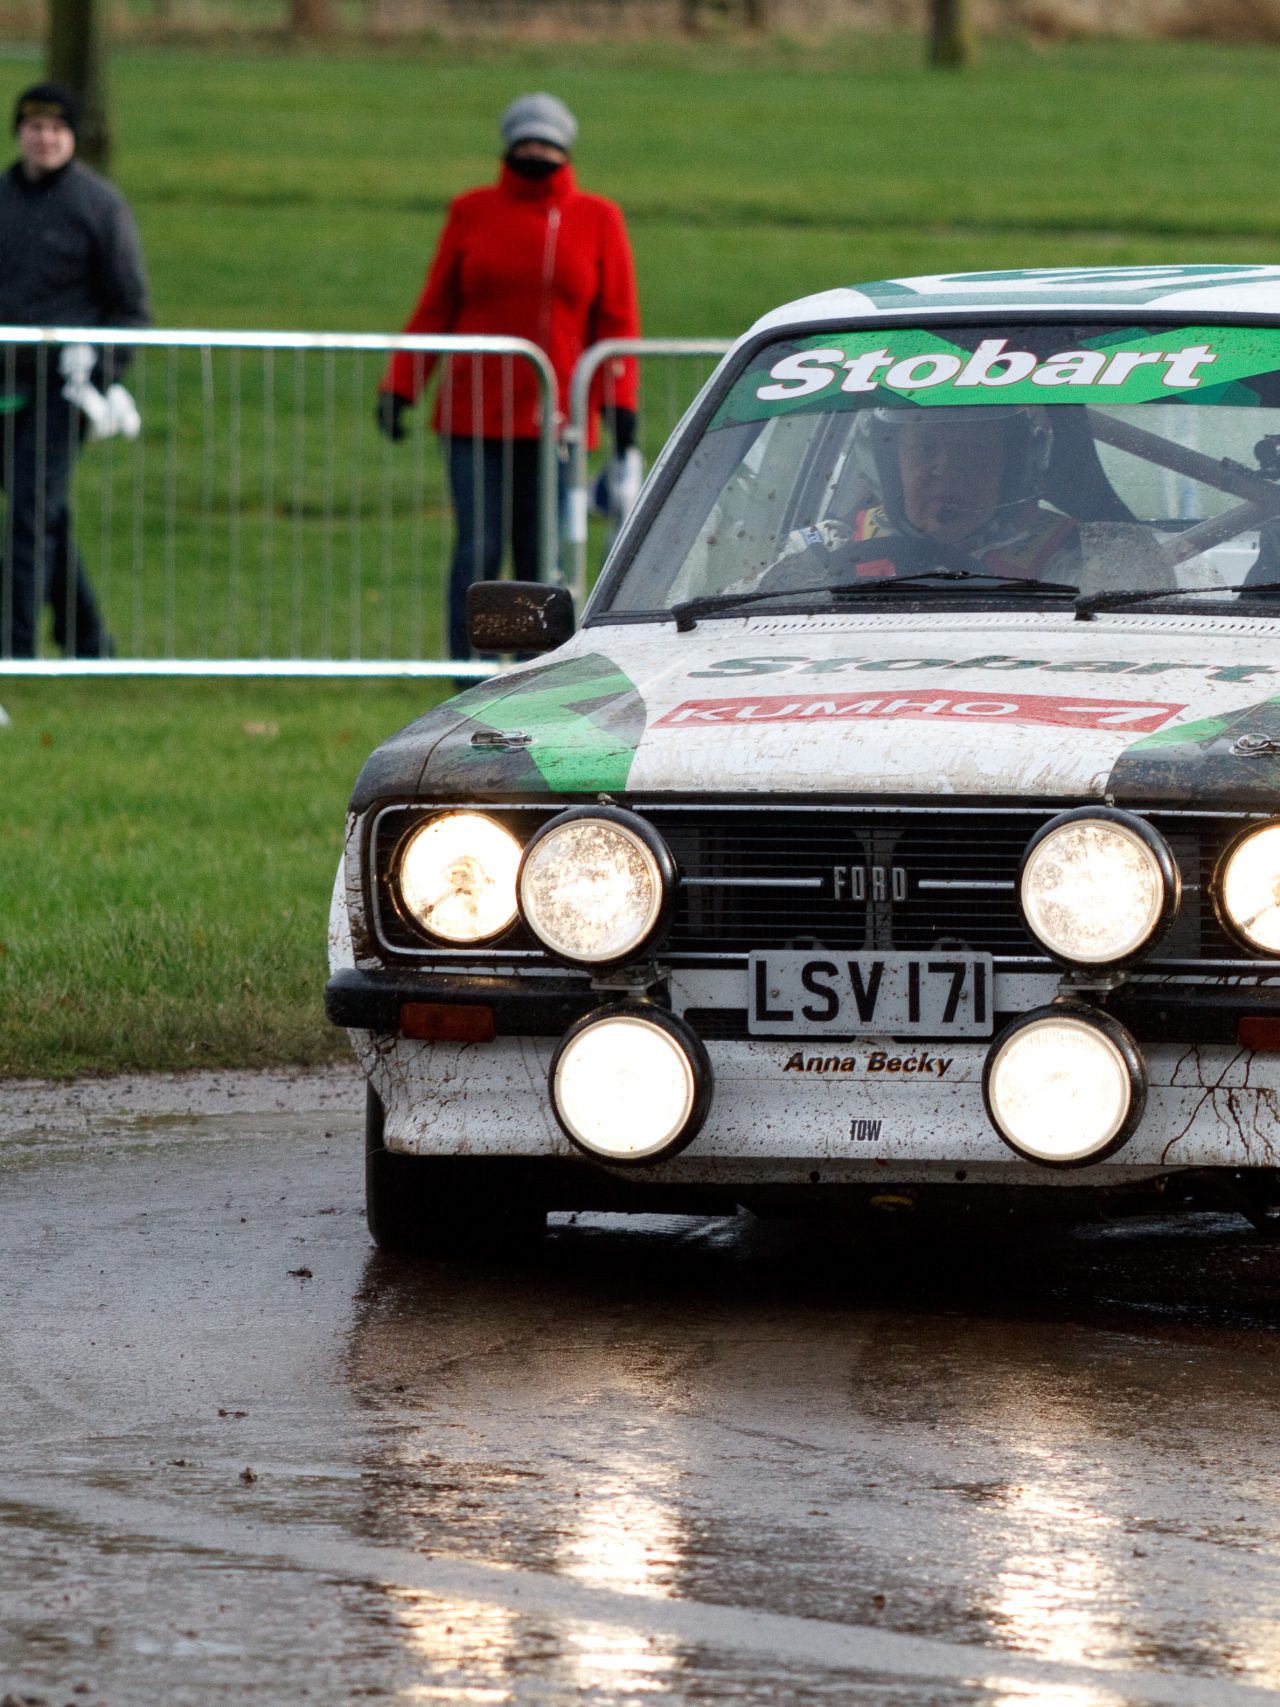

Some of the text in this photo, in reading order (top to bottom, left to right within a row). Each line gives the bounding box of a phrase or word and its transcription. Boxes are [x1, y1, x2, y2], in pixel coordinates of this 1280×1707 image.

[756, 338, 1219, 400] Stobart
[686, 655, 1280, 683] Stobart
[670, 699, 1023, 724] KUMHO
[833, 866, 907, 901] FORD
[755, 960, 986, 1023] LSV 171
[783, 1051, 954, 1078] Anna Becky
[849, 1118, 882, 1142] TOW
